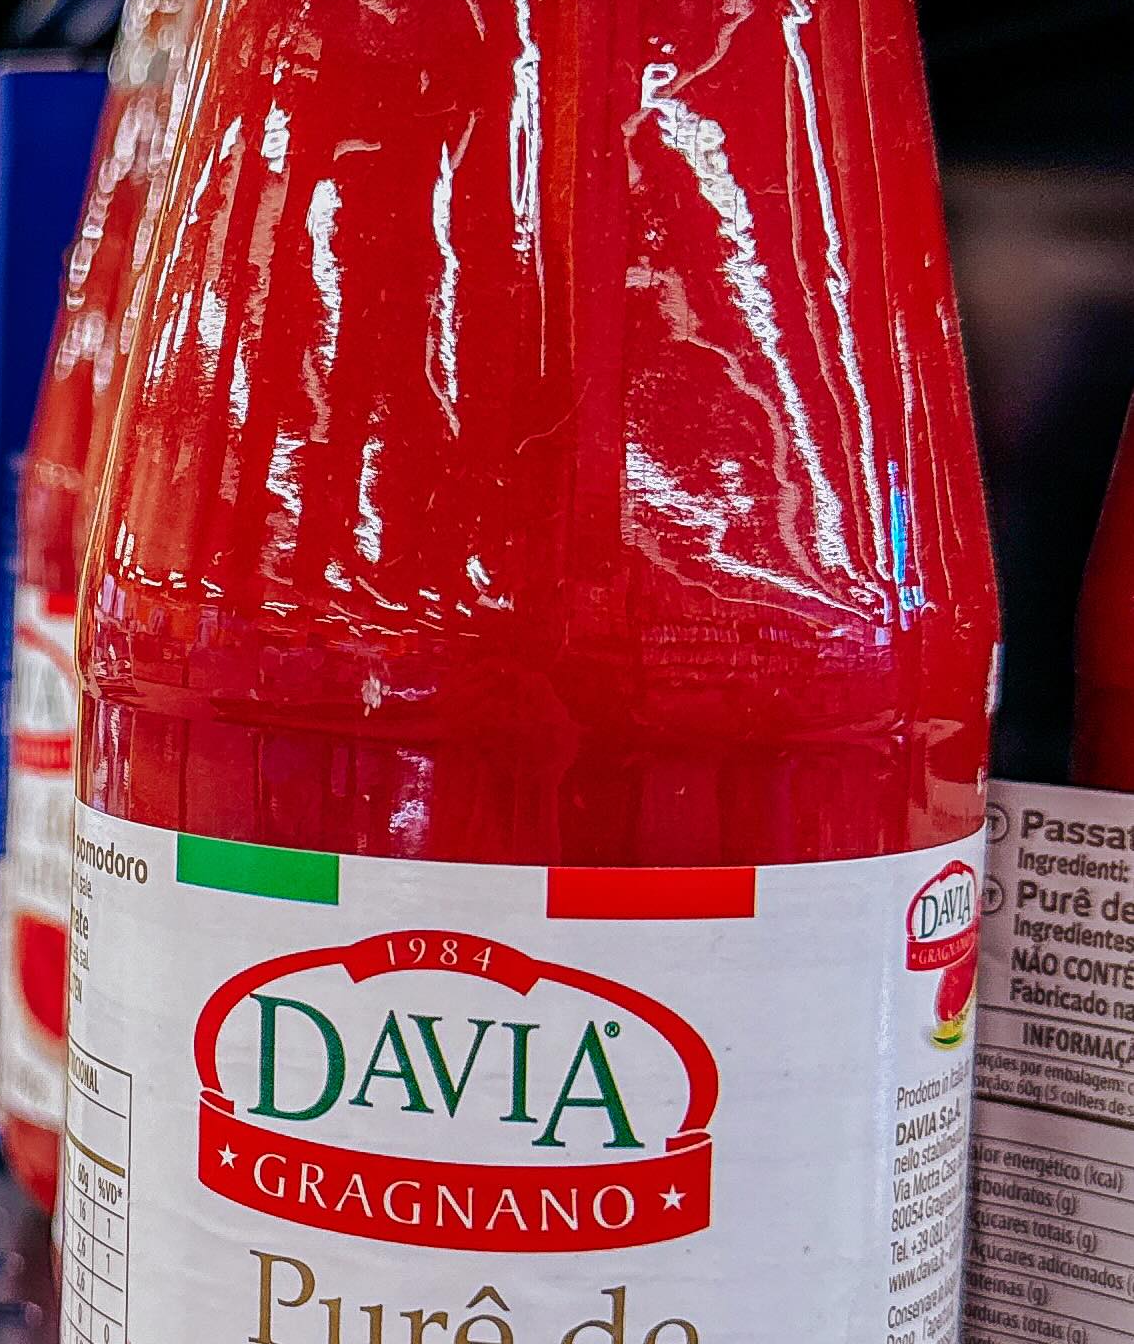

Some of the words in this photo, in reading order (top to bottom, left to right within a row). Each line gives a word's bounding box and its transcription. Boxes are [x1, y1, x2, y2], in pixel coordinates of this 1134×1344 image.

[76, 833, 148, 885] pomodoro
[1017, 847, 1130, 883] Ingredienti:
[917, 879, 972, 940] DAVIA
[1017, 879, 1092, 917] Purê
[385, 937, 494, 972] 1984
[1011, 944, 1059, 976] NÃO
[1009, 977, 1108, 1017] Fabricado
[896, 1079, 941, 1111] Prodotto
[895, 1111, 937, 1147] DAVIA
[252, 1153, 636, 1233] GRAGNANO
[892, 1177, 911, 1204] Via
[912, 1167, 940, 1197] Motta
[891, 1200, 924, 1233] 80054
